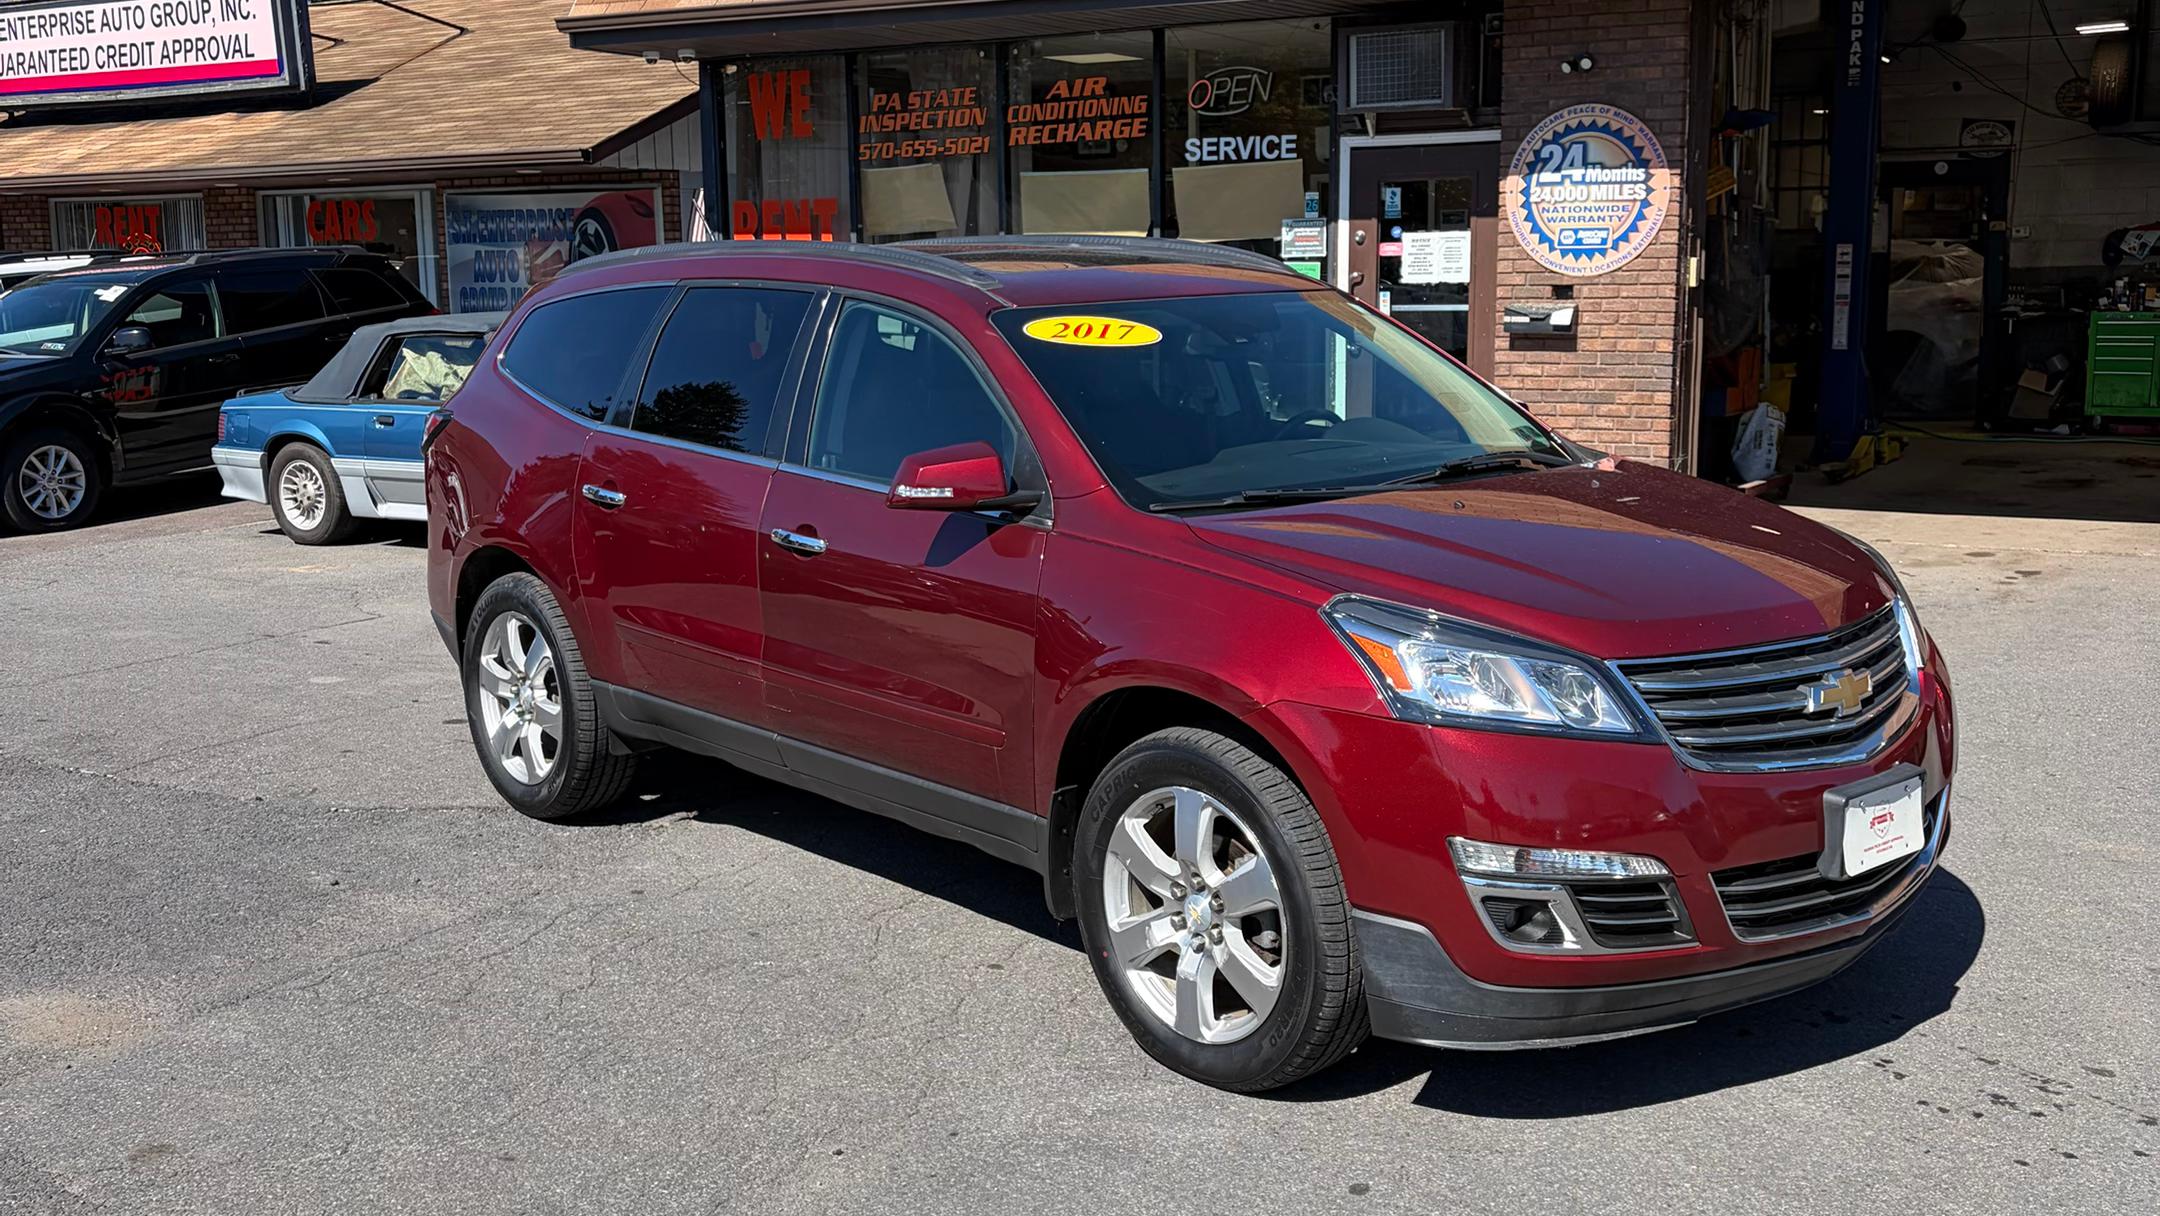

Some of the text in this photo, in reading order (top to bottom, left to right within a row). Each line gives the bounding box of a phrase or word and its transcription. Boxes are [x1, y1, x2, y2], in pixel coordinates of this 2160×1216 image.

[0, 0, 257, 41] ENTERPRISE AUTO GROUP, INC.
[95, 41, 155, 69] CREDIT
[160, 33, 256, 65] APPROVAL
[1849, 29, 1863, 66] PAK
[872, 87, 977, 112] PA STATE
[1045, 76, 1108, 99] AIR
[1188, 72, 1273, 109] OPEN
[749, 69, 814, 141] WE
[1007, 95, 1149, 124] CONDITIONING
[859, 106, 988, 134] INSPECTION
[1009, 118, 1150, 146] RECHARGE
[859, 135, 991, 161] 570-655-5021
[1185, 134, 1298, 162] SERVICE
[1513, 146, 1527, 169] NAPA
[1526, 113, 1565, 143] AUTOCARE
[1567, 106, 1597, 116] PEACE
[1599, 106, 1610, 115] OF
[1638, 127, 1665, 168] WARRANTY
[1539, 143, 1646, 183] 24 Months
[1306, 199, 1319, 212] 26
[1530, 183, 1647, 204] 24,000 MILES
[307, 200, 378, 241] CARS
[733, 198, 838, 241] RENT
[1541, 204, 1630, 214] NATIONWIDE
[1546, 215, 1625, 223] WARRANTY
[96, 206, 161, 247] RENT
[1511, 211, 1531, 246] HONORED
[1530, 246, 1538, 256] AT
[1539, 252, 1587, 273] CONVENIENT
[1590, 252, 1632, 273] LOCATIONS
[1632, 207, 1664, 256] NATIONALLY
[473, 249, 520, 283] AUTO
[460, 286, 509, 314] GROUP
[1050, 322, 1137, 340] 2017
